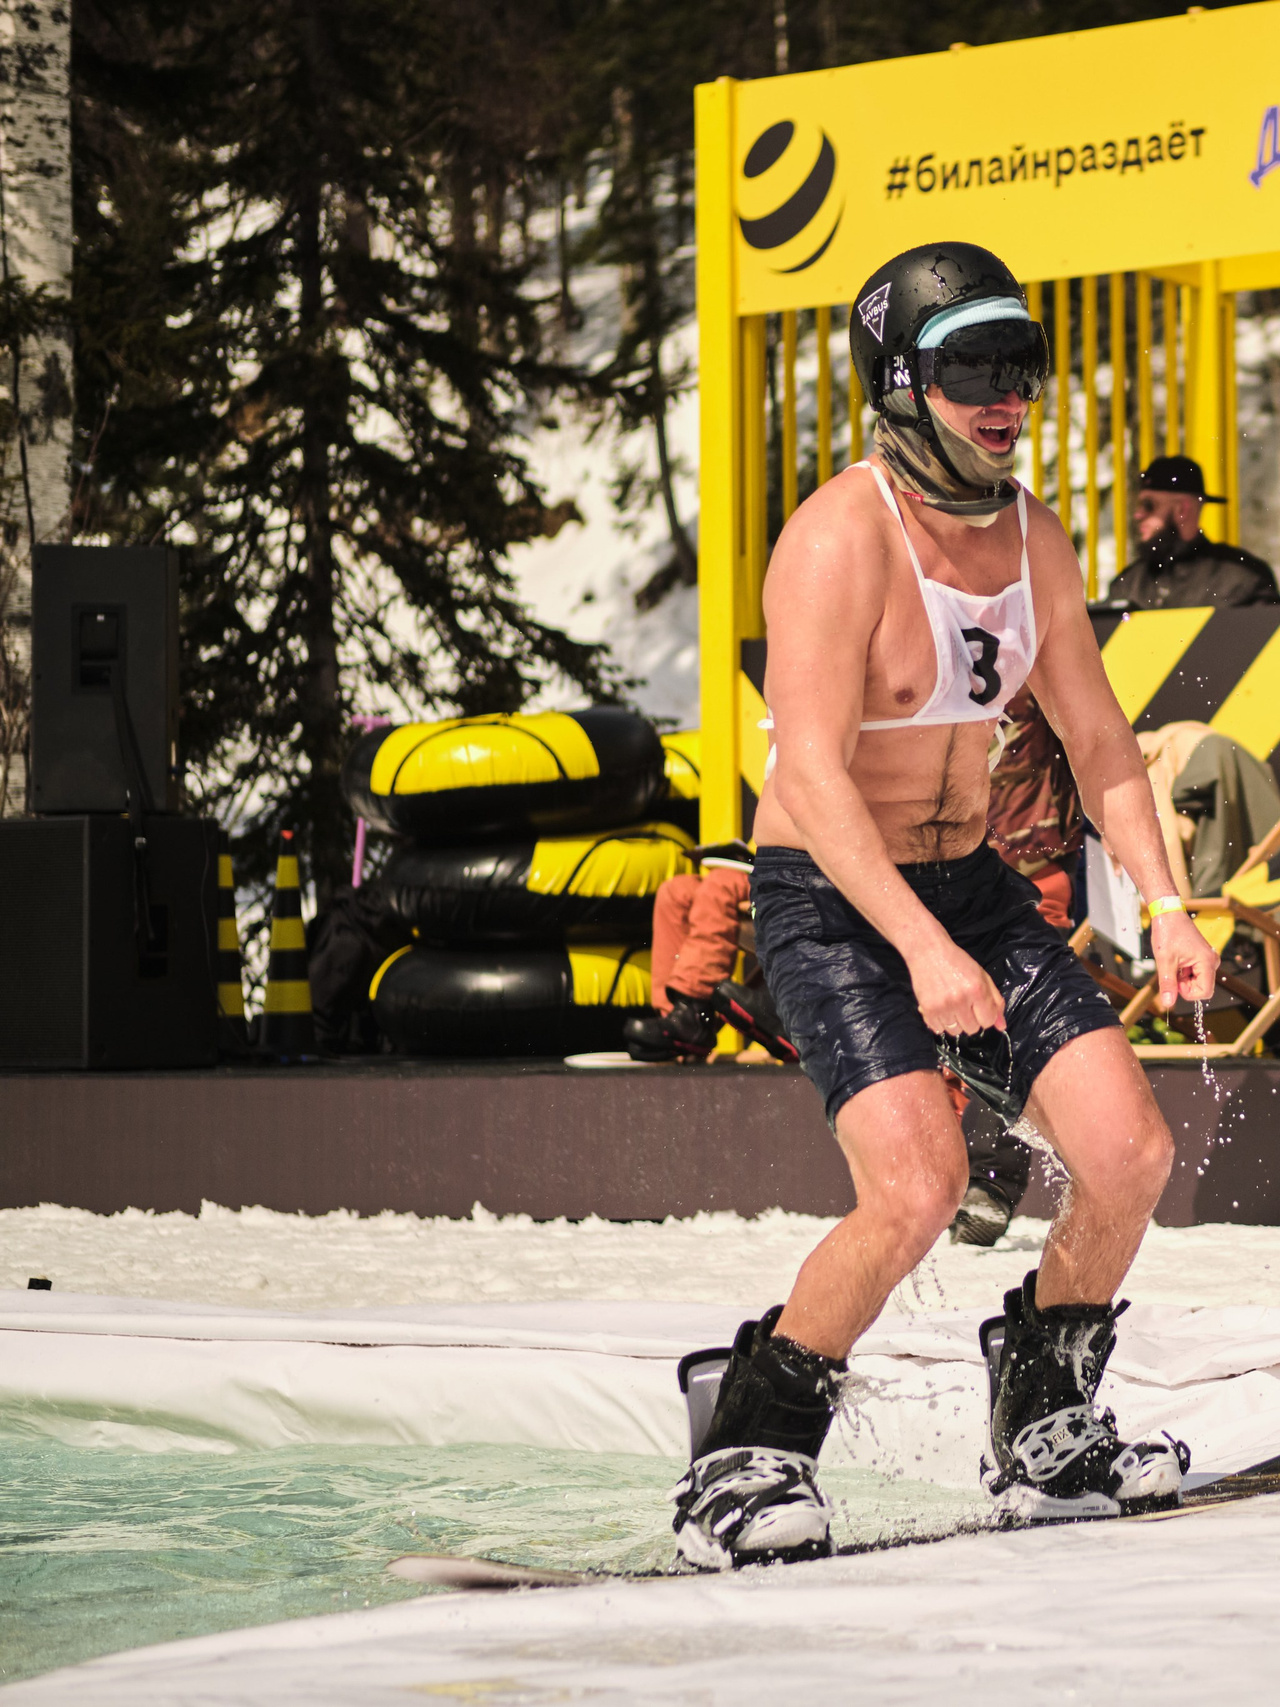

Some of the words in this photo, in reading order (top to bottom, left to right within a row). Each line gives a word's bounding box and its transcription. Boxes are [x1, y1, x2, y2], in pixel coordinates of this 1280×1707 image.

[886, 121, 1206, 200] #билайнраздаёт
[961, 626, 1002, 707] 3
[1052, 1428, 1069, 1444] FIX
